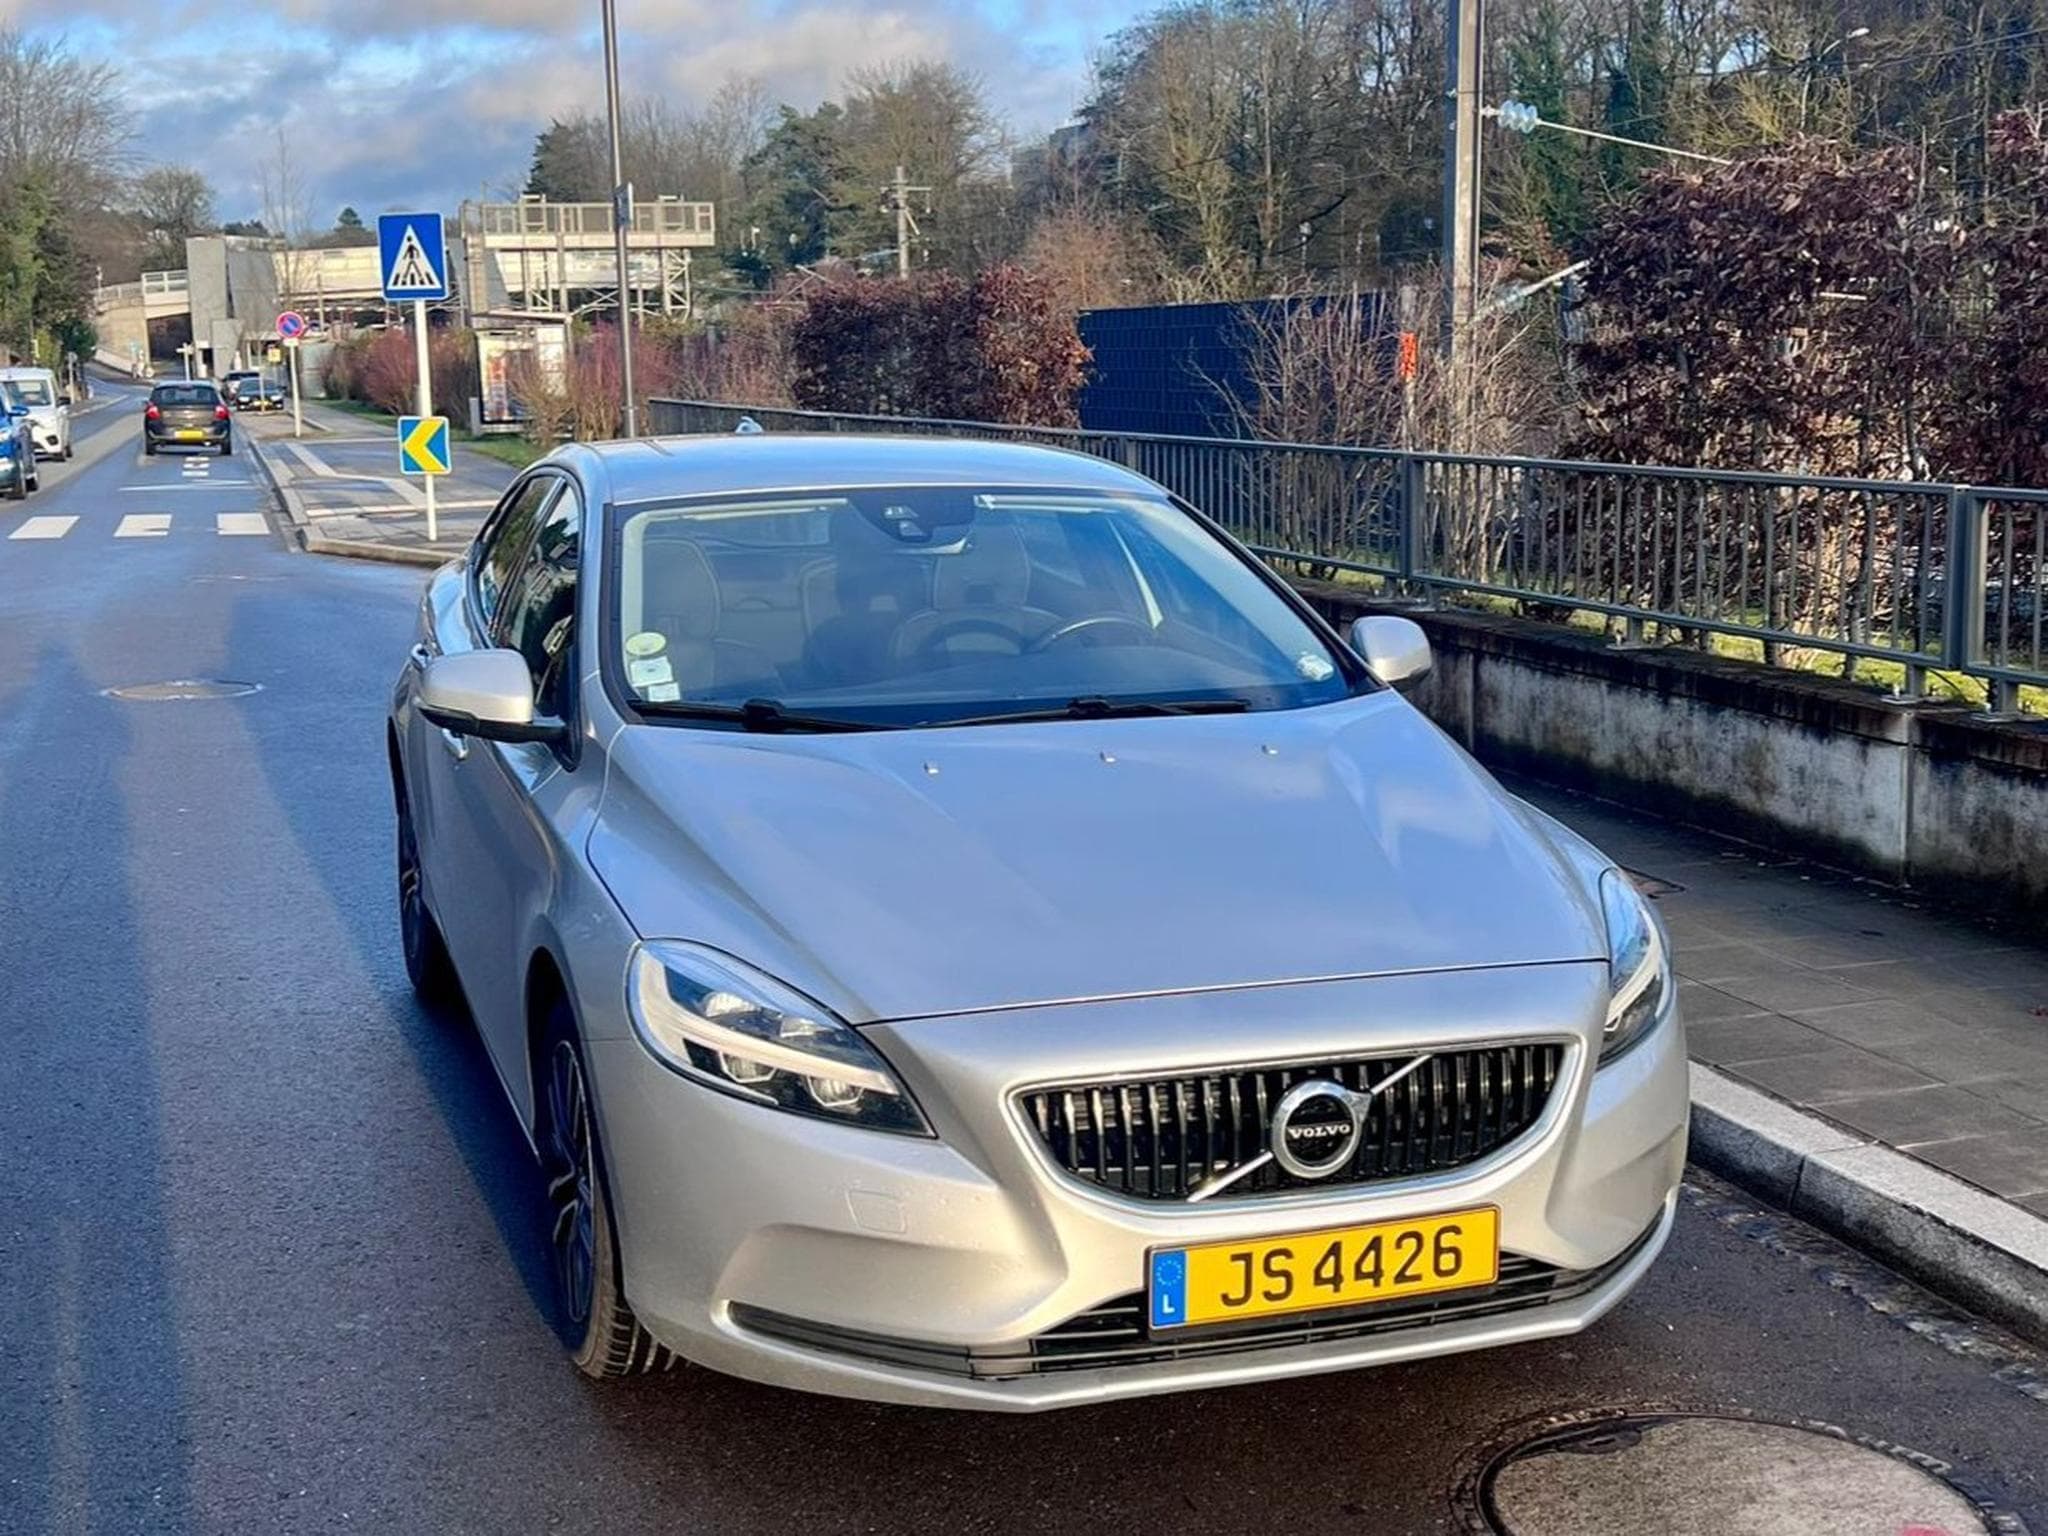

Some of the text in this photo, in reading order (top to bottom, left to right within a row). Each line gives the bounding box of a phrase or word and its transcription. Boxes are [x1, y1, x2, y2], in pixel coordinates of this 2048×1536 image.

[1287, 1123, 1351, 1139] VOLVO
[1220, 1224, 1463, 1307] JS 4426
[1162, 1293, 1175, 1314] L
